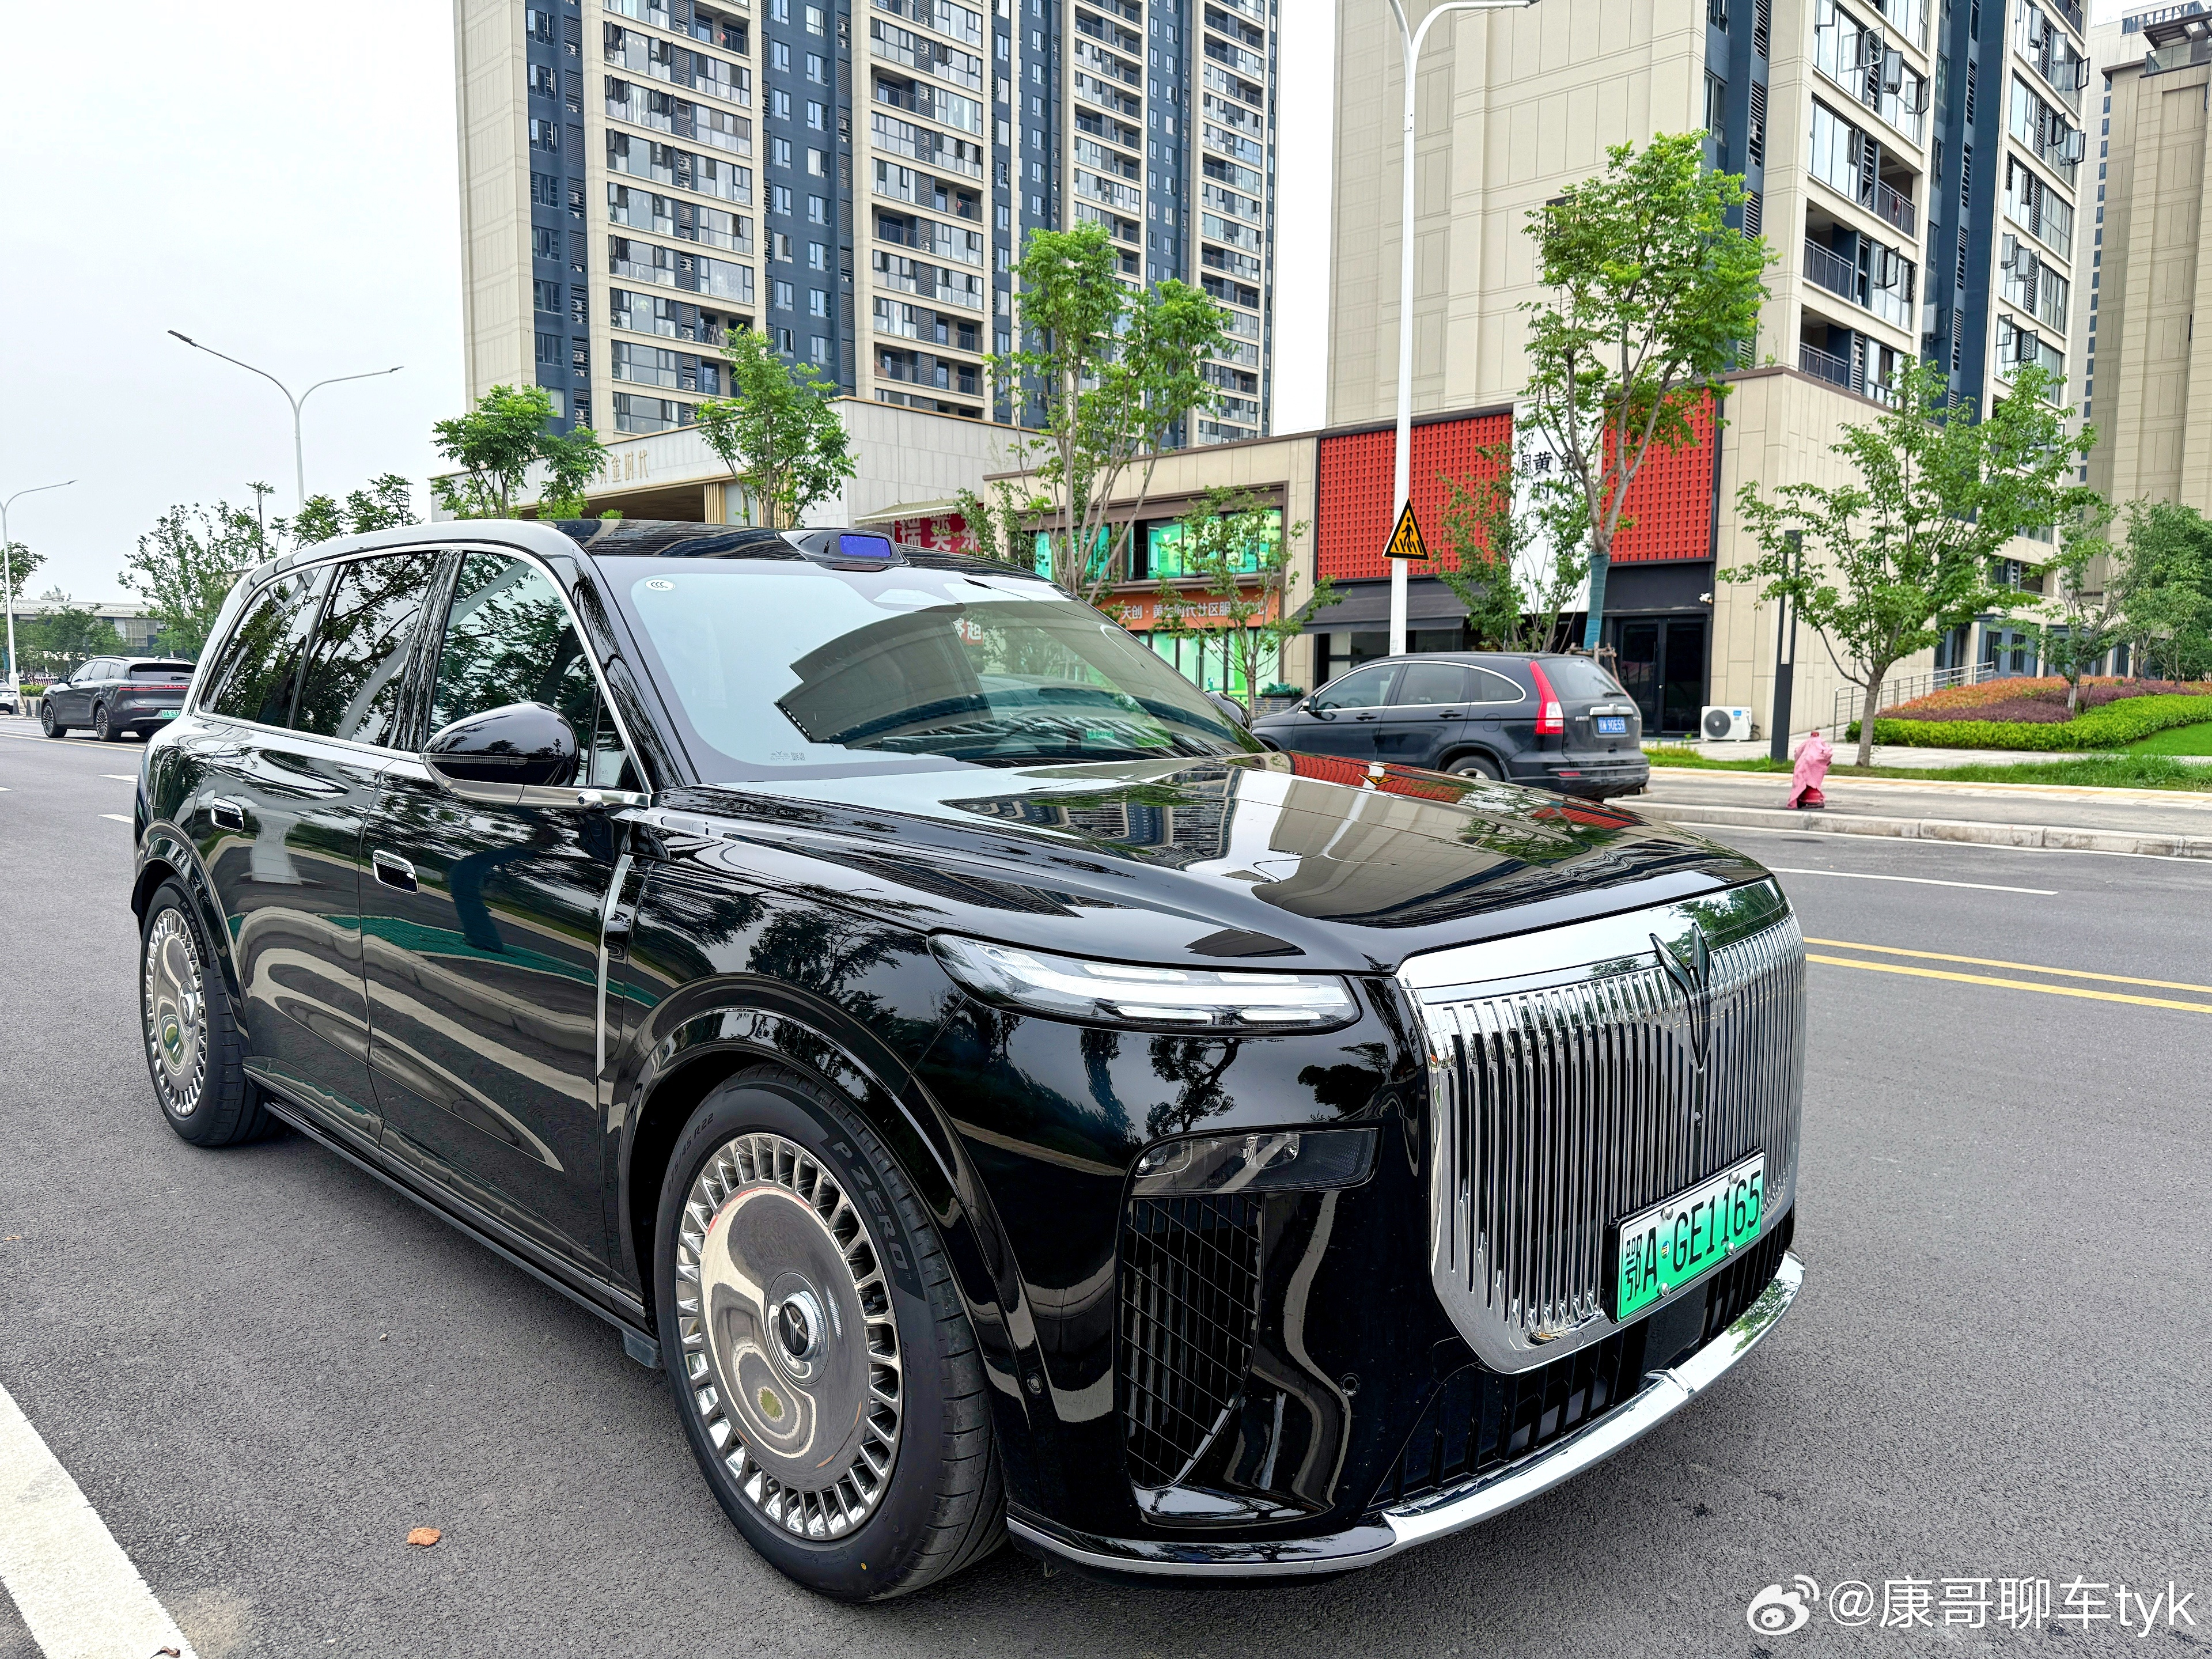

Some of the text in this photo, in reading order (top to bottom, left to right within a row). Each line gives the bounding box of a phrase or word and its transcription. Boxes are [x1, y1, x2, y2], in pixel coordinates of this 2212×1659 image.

[186, 911, 205, 956] ZERO
[694, 1112, 714, 1139] R22
[832, 1141, 909, 1270] P ZERO
